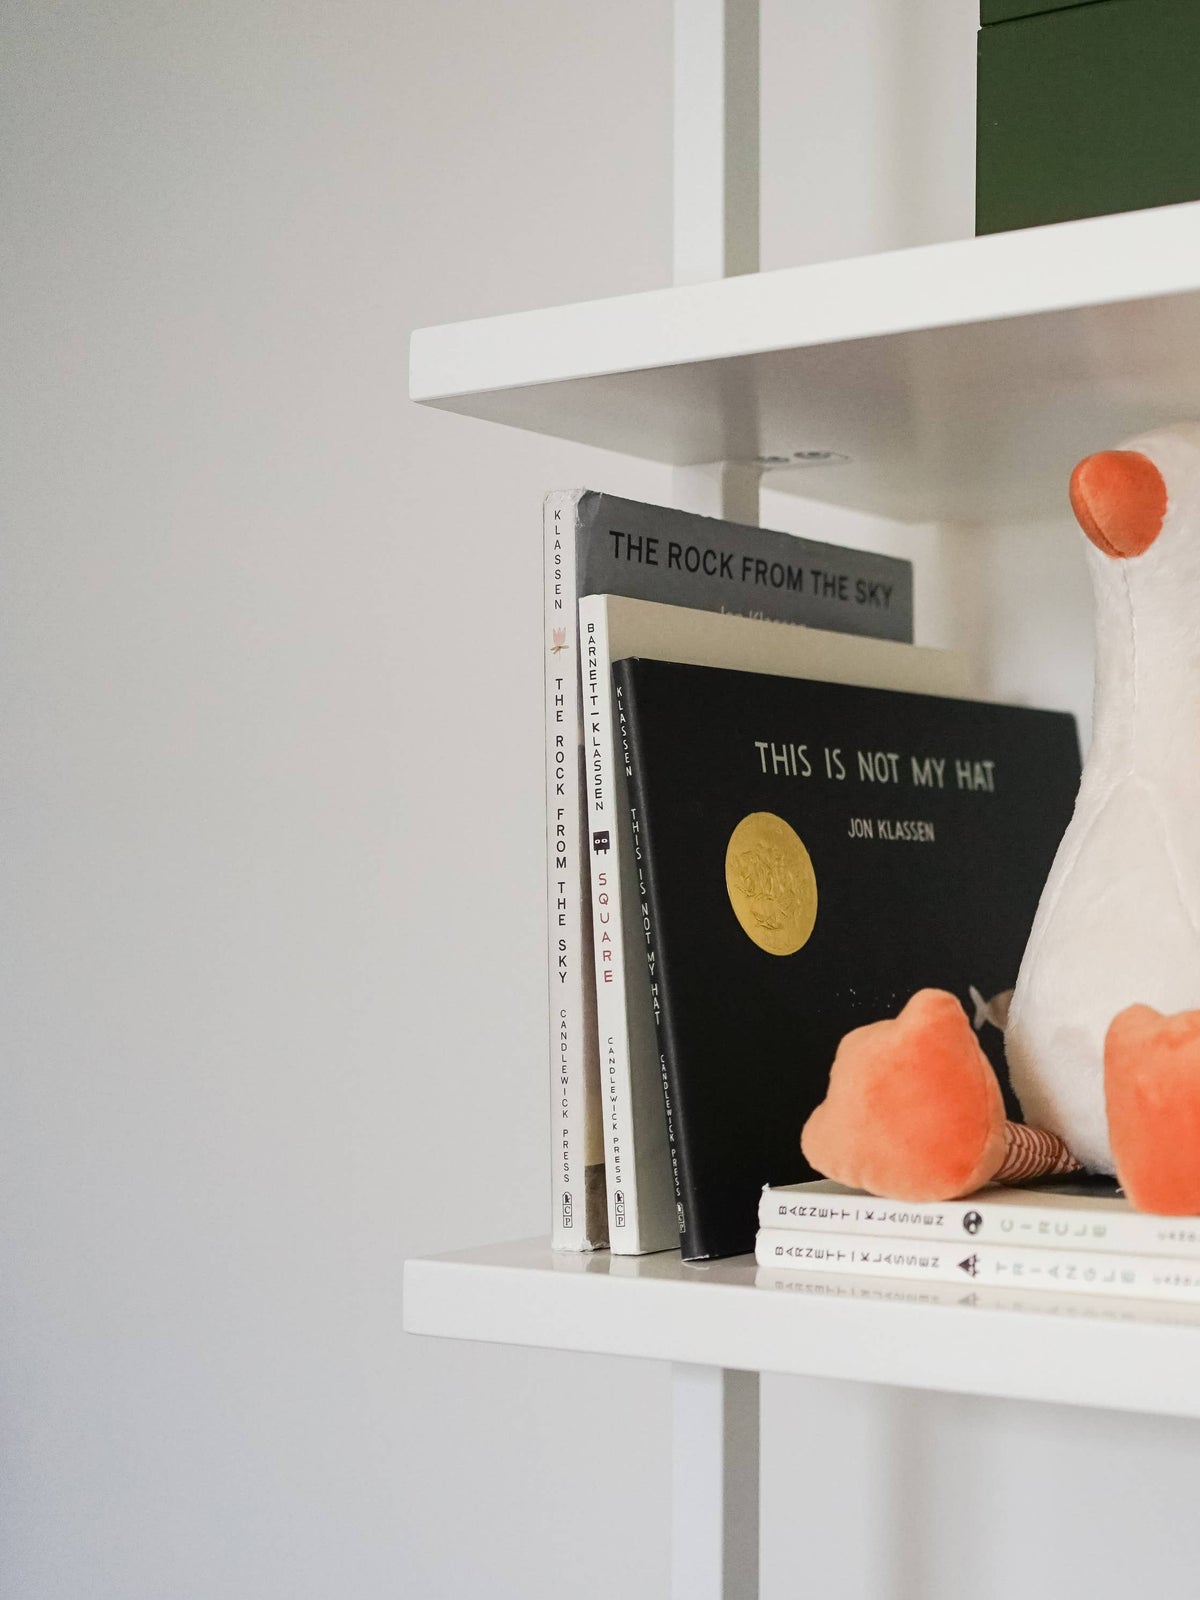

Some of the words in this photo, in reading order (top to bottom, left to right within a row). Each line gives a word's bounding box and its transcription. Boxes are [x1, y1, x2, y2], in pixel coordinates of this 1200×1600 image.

[554, 510, 562, 610] KLASSEN
[609, 530, 659, 566] THE
[668, 542, 733, 580] ROCK
[741, 557, 803, 593] FROM
[810, 570, 848, 601] THE
[855, 579, 893, 608] SKY
[555, 678, 564, 722] THE
[616, 686, 633, 777] KLASSEN
[555, 735, 565, 795] ROCK
[754, 741, 812, 778] THIS
[824, 747, 846, 781] IS
[857, 750, 899, 784] NOT
[910, 755, 946, 789] MY
[955, 759, 995, 793] HAT
[556, 809, 567, 869] FROM
[630, 808, 642, 860] THIS
[848, 817, 874, 840] JON
[877, 819, 935, 842] KLASSEN
[557, 882, 566, 926] THE
[639, 868, 647, 895] IS
[598, 872, 613, 983] SQUARE
[641, 902, 652, 945] NOT
[558, 939, 567, 983] SKY
[647, 952, 655, 976] MY
[651, 983, 660, 1025] HAT
[560, 1009, 569, 1119] CANDLEWICK
[607, 1037, 618, 1131] CANDLEWICK
[613, 1137, 622, 1184] PRESS
[660, 1054, 675, 1141] CANDLEWICK
[671, 1148, 681, 1197] PRESS
[562, 1129, 570, 1183] PRESS
[1000, 1218, 1107, 1238] CIRCLE
[995, 1260, 1136, 1284] TRIANGLE
